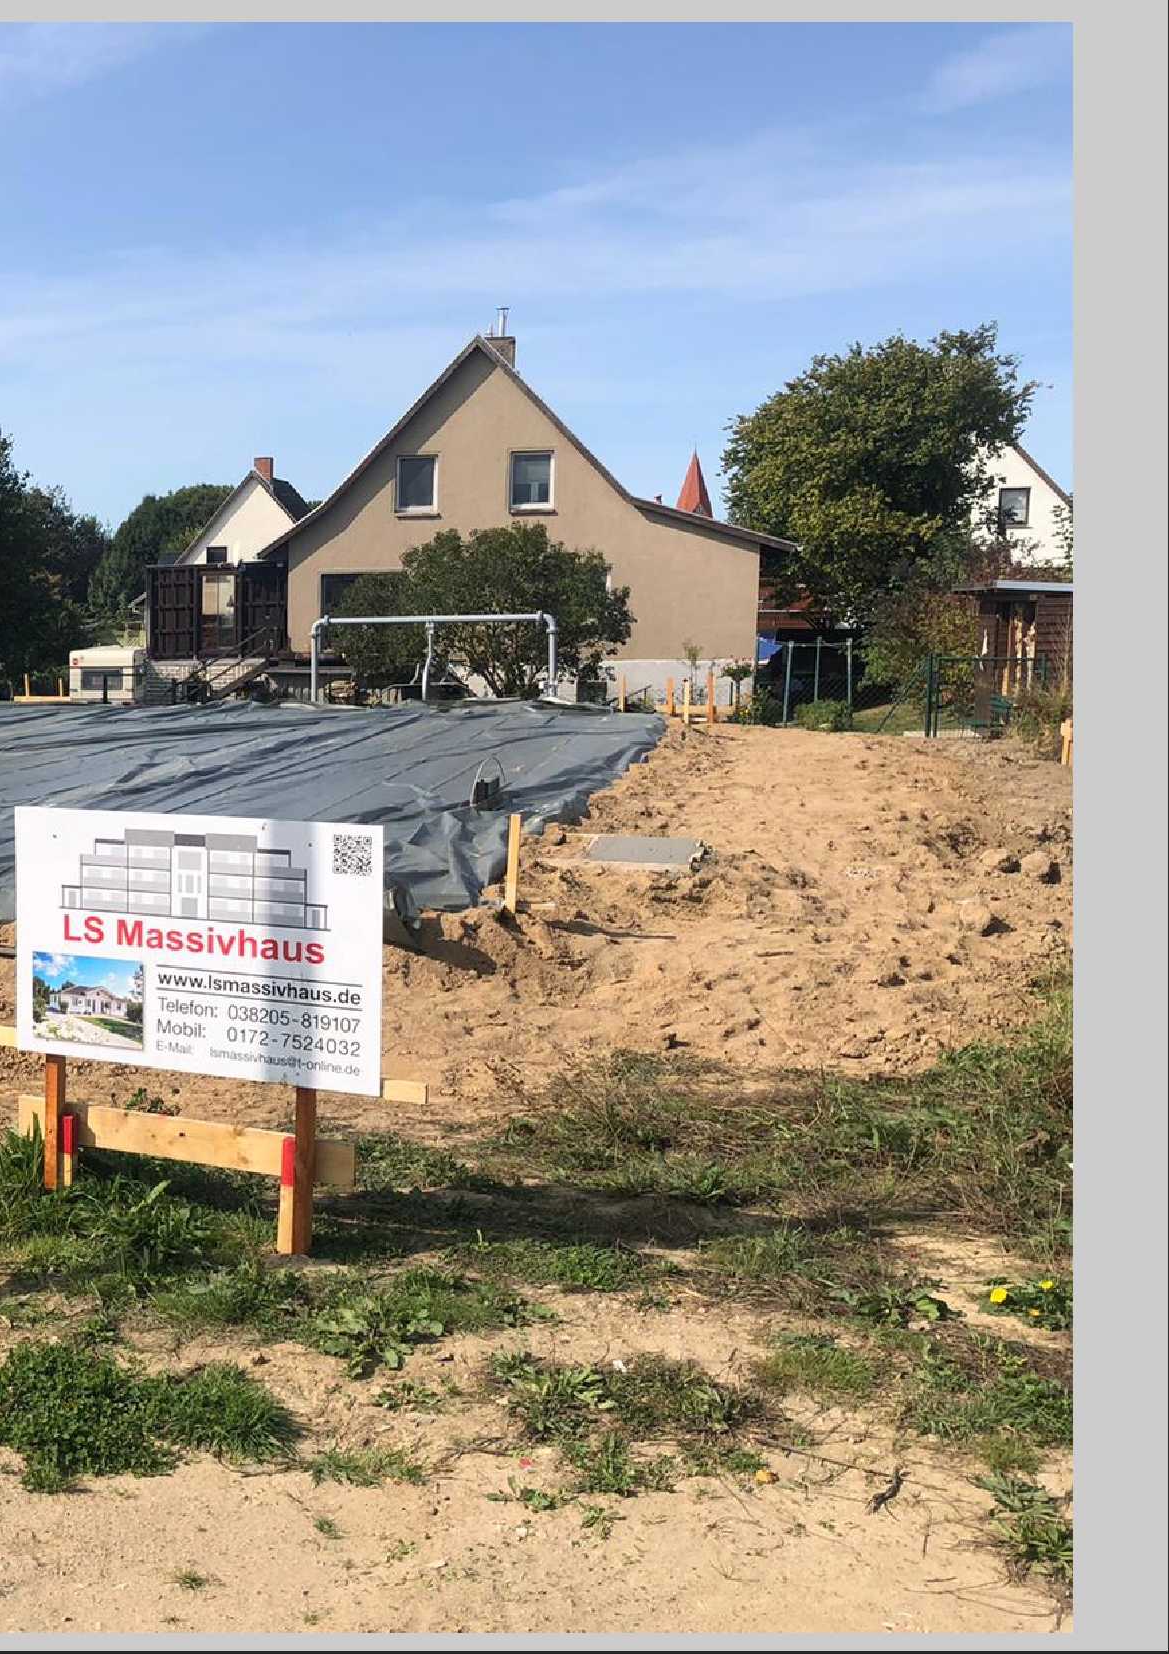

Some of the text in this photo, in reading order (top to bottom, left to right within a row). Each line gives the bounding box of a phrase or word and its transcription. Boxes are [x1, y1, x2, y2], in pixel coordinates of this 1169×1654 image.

[63, 914, 325, 965] LS Massivhaus
[157, 972, 361, 1005] www.lsmassivhaus.de
[158, 996, 361, 1033] Telefon: 038205-819107
[156, 1019, 361, 1058] Mobil: 0172-7524032
[209, 1048, 361, 1076] lsmassivhaus@t-online.de
